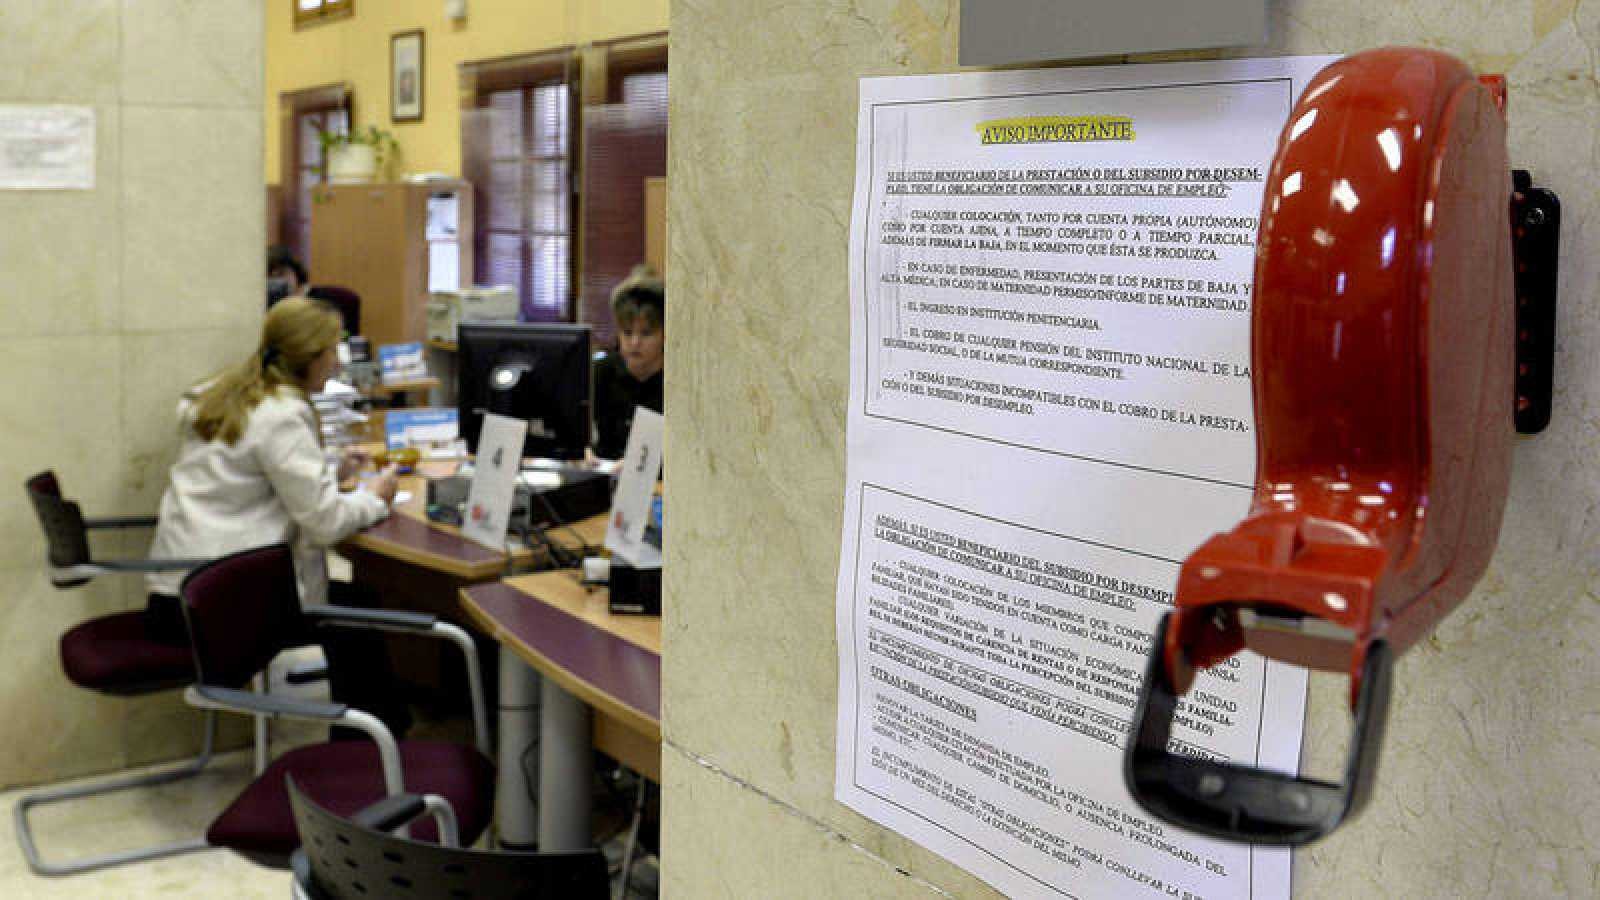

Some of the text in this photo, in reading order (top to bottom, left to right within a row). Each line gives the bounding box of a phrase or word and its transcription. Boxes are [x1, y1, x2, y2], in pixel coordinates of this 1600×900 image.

[983, 122, 1132, 143] AVISO IMPORTANTE
[1104, 169, 1127, 181] DEL
[1129, 169, 1182, 181] SUBSIDIO
[1186, 169, 1210, 181] POR
[1213, 169, 1262, 181] DESEM-
[1020, 184, 1082, 196] COMUNICAR
[1158, 185, 1173, 196] DE
[1026, 211, 1059, 222] TANTO
[1063, 212, 1082, 224] POR
[1086, 213, 1128, 225] CUENTA
[1132, 214, 1172, 227] PROPIA
[1057, 228, 1112, 240] COMPLETO
[1118, 230, 1126, 241] O
[1132, 230, 1140, 241] A
[1150, 230, 1192, 243] TIEMPO
[1033, 242, 1084, 254] MOMENTO
[1086, 244, 1107, 257] QUE
[1138, 246, 1150, 258] SE
[1100, 273, 1114, 286] DE
[1118, 275, 1138, 288] LOS
[1142, 277, 1184, 291] PARTES
[1188, 280, 1205, 292] DE
[1208, 281, 1238, 295] BAJA
[1243, 283, 1250, 296] Y
[1148, 293, 1164, 305] DE
[1086, 347, 1142, 365] INSTITUTO
[1146, 355, 1208, 373] NACIONAL
[1213, 361, 1229, 376] DE
[1234, 364, 1250, 378] LA
[1119, 403, 1158, 420] COBRO
[1162, 409, 1177, 423] DE
[1180, 411, 1196, 425] LA
[1121, 581, 1173, 604] DESEMPL
